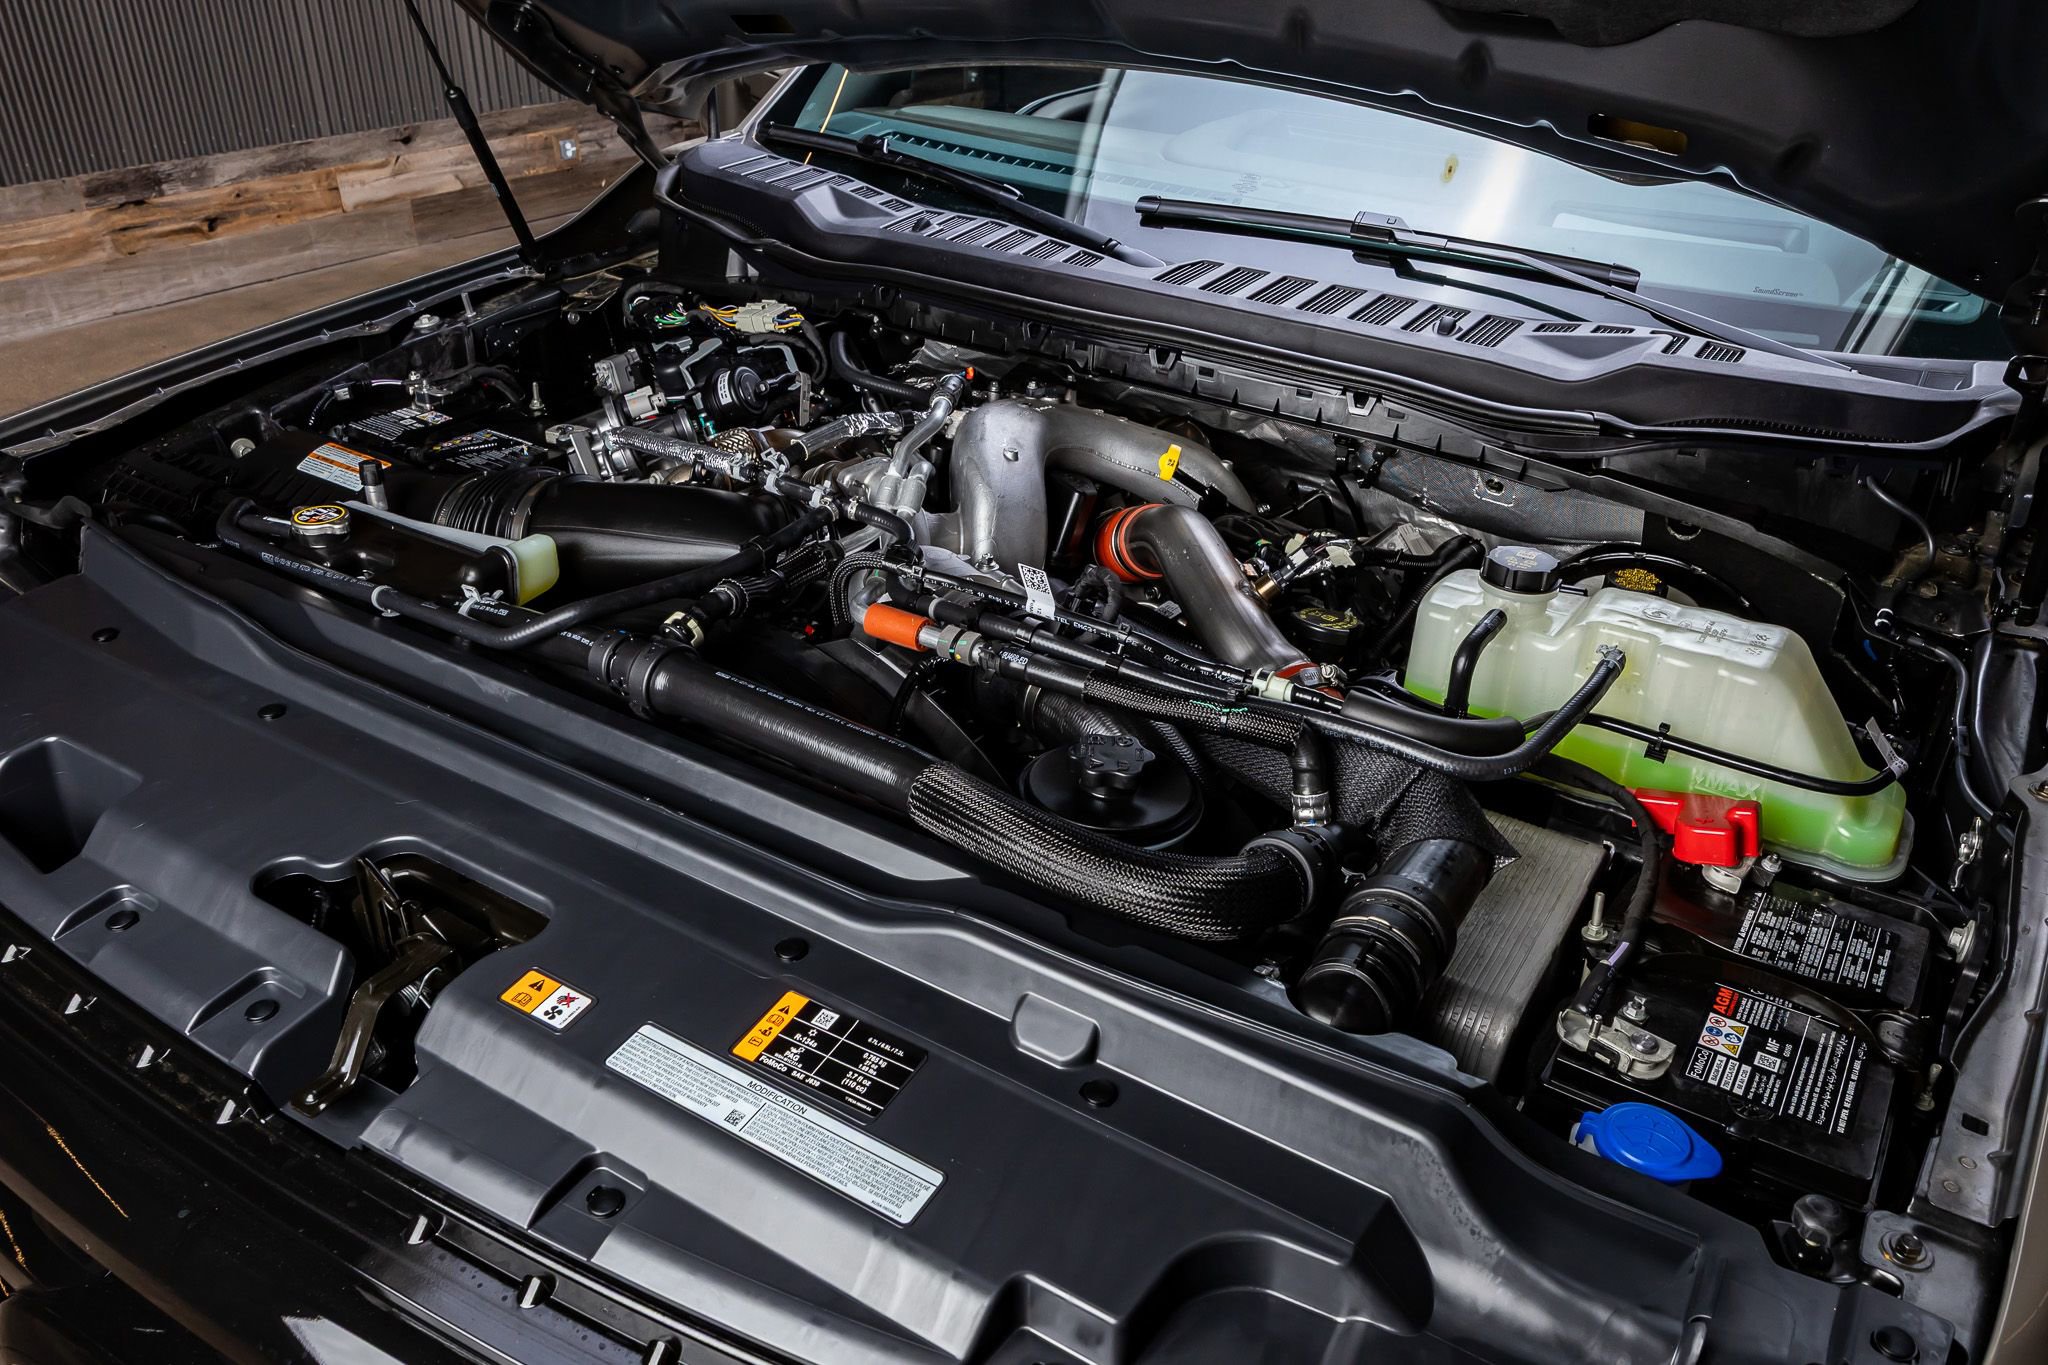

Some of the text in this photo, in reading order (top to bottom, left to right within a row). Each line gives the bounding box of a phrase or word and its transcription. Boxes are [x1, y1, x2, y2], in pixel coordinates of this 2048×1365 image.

[1752, 285, 1799, 297] SoundScreen
[1705, 772, 1761, 801] MAX
[1711, 986, 1732, 1014] AGM
[792, 1032, 819, 1048] R-134a
[1764, 1036, 1781, 1053] MF
[782, 1050, 801, 1062] PAG
[876, 1058, 889, 1068] kg
[1690, 1048, 1709, 1079] FoMoCo
[703, 1069, 717, 1079] MOTOR
[716, 1076, 735, 1088] COMPANY
[757, 1054, 821, 1087] FoMoCo SAE J639
[845, 1070, 859, 1080] 3.7
[860, 1078, 872, 1086] oz
[707, 1085, 723, 1095] VEHICLE
[722, 1092, 738, 1103] LIMITED
[839, 1077, 868, 1094] (110 cc)
[671, 1086, 687, 1096] VEHICLE
[685, 1094, 707, 1108] WARRANTY
[742, 1096, 760, 1107] RELATED
[746, 1080, 808, 1114] MODIFICATION
[1837, 1118, 1846, 1127] NOT
[1844, 1093, 1853, 1102] PAS
[868, 1156, 890, 1169] COMPANY
